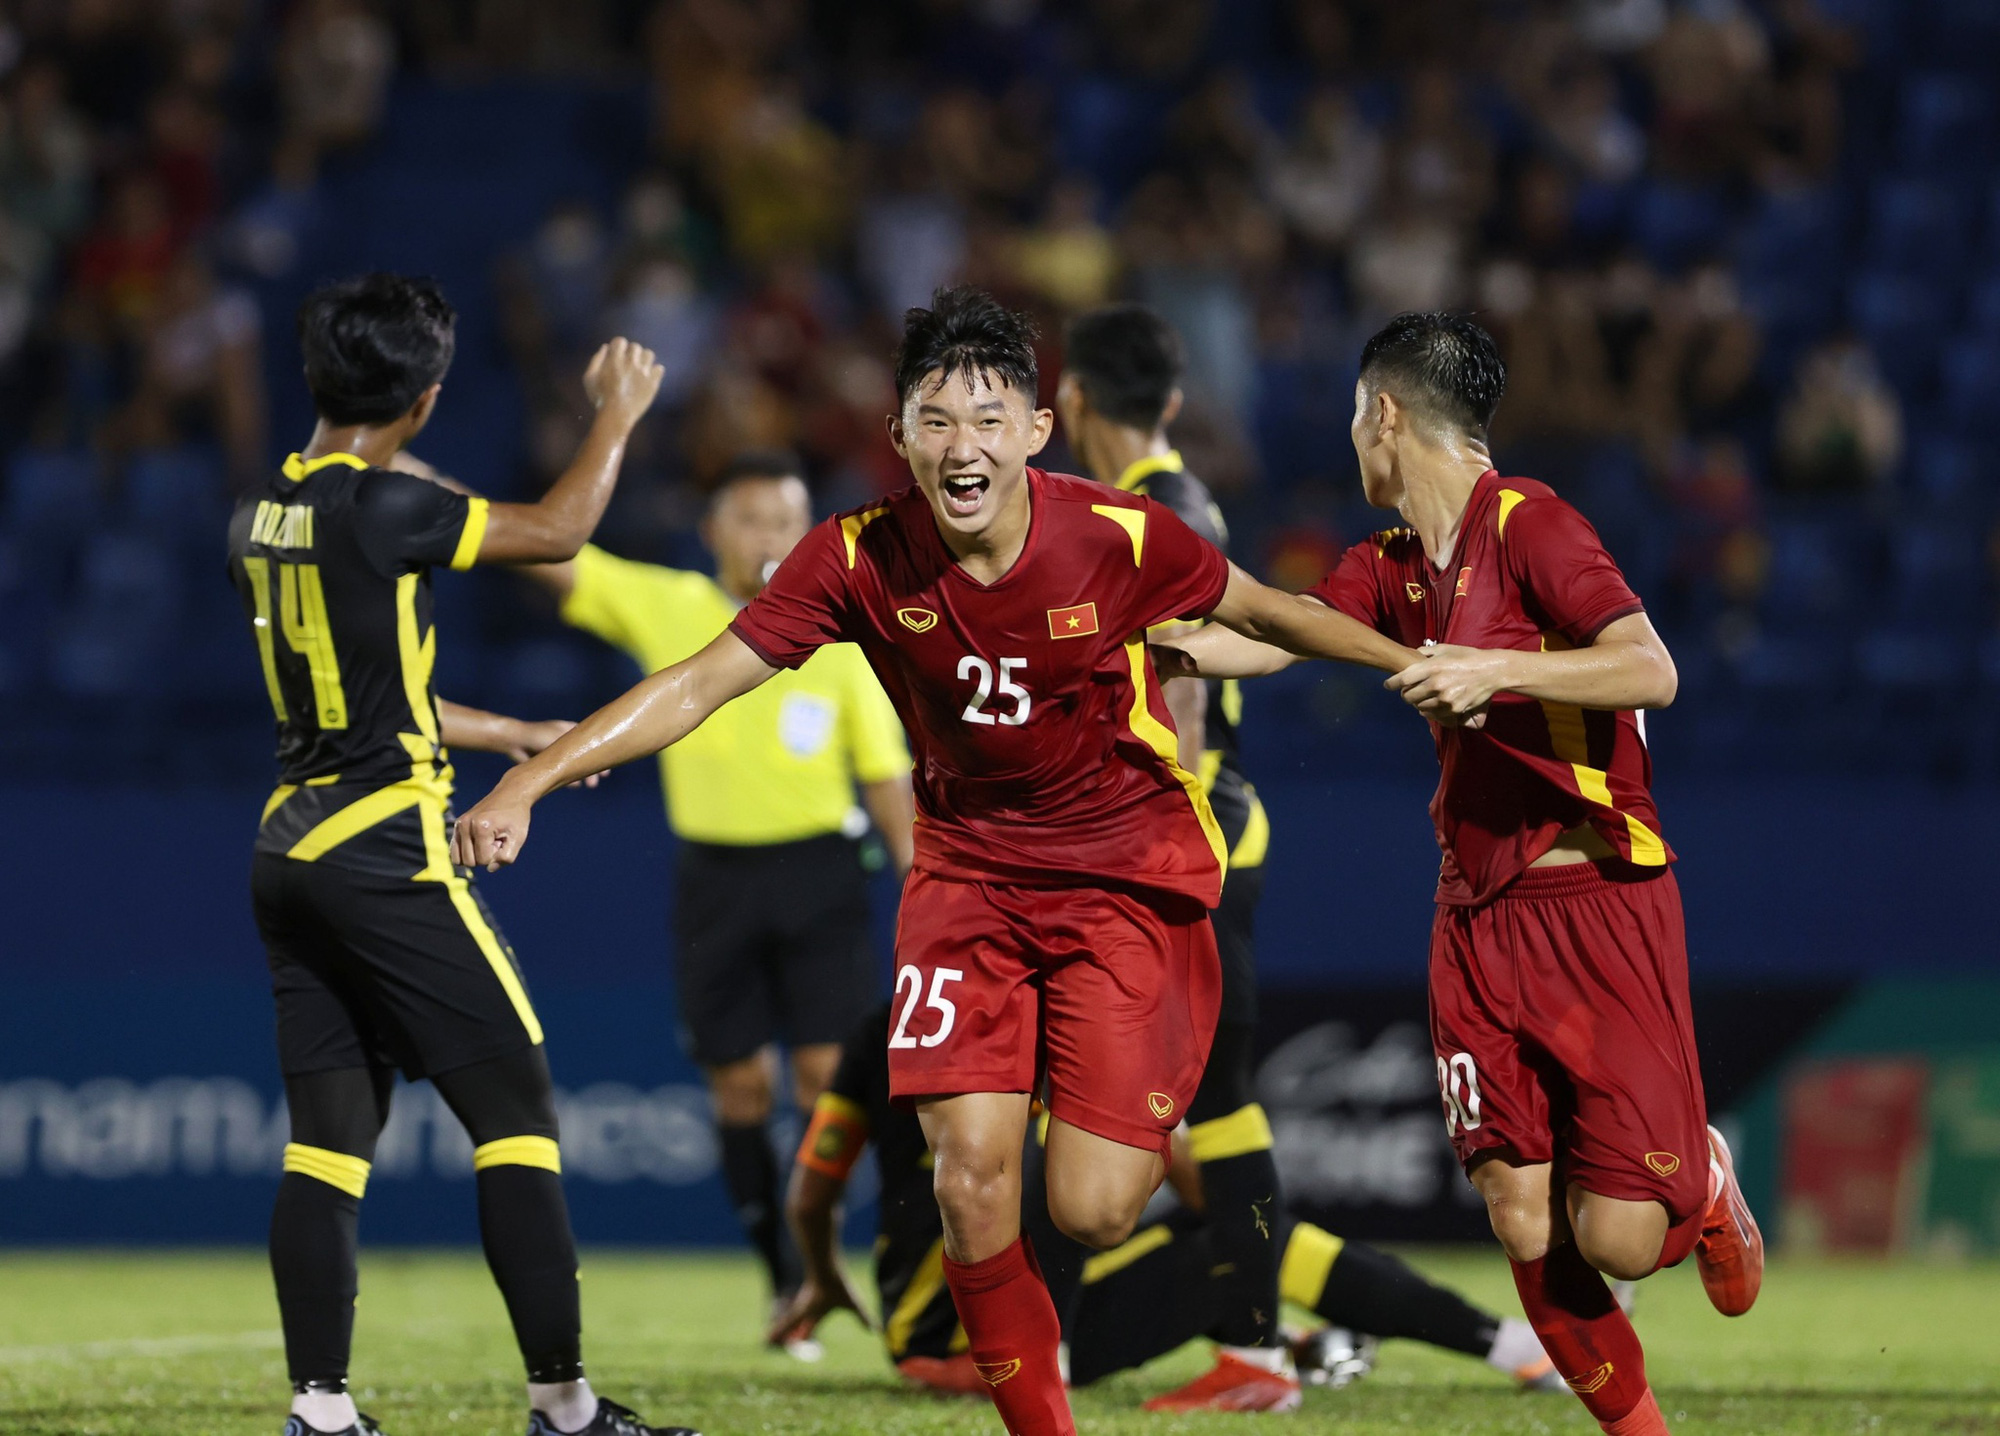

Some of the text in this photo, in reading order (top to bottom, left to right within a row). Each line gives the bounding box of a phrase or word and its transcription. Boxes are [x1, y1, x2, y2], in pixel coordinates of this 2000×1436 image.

[957, 655, 1031, 725] 25
[888, 965, 963, 1048] 25
[1437, 1052, 1481, 1137] 30
